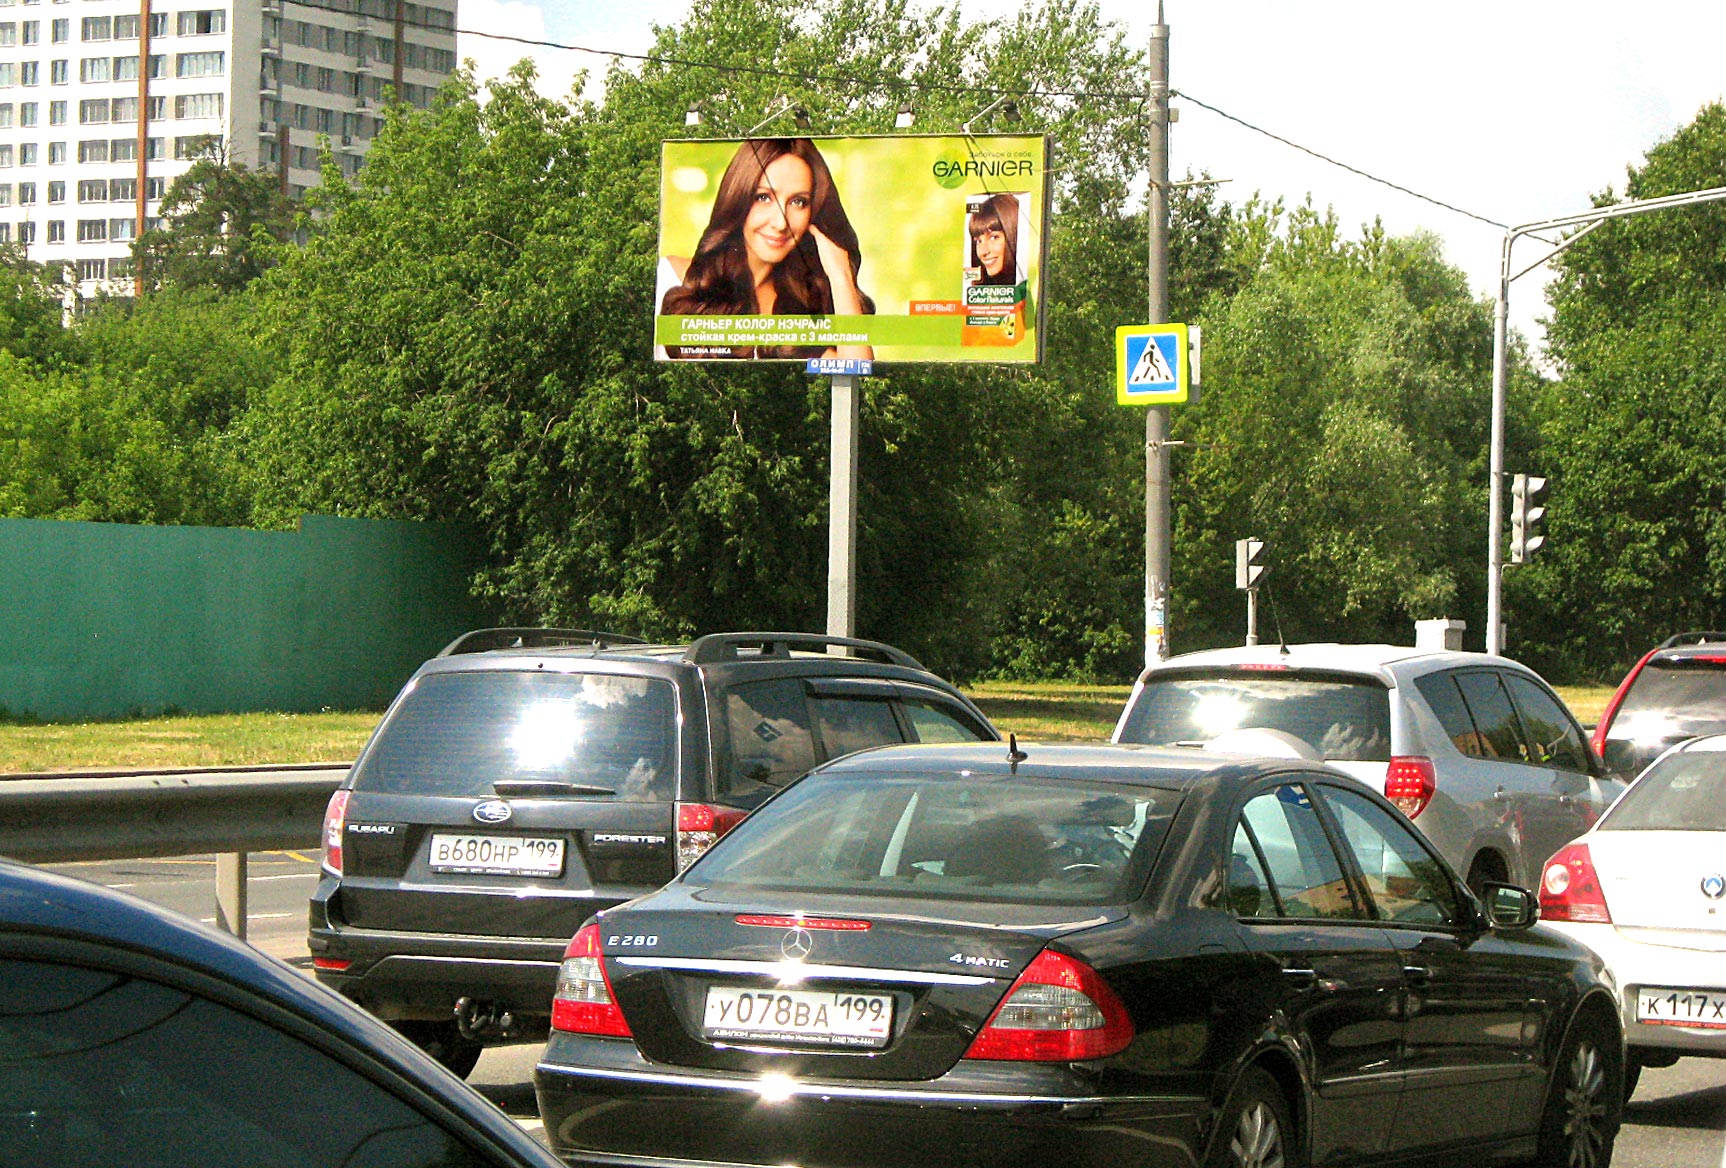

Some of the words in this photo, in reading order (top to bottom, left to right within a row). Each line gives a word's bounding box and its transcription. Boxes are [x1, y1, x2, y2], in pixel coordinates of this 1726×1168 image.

[933, 160, 1033, 177] GARNIER
[968, 287, 1014, 296] GARNIER
[915, 303, 956, 312] ВПЕРВЫЕ!
[681, 318, 732, 329] ГАРНЬЕР
[735, 318, 775, 329] КОЛОР
[778, 318, 831, 329] НЭЧРАЛС
[680, 331, 725, 342] стойкая
[727, 332, 798, 344] крем-краска
[800, 333, 807, 342] с
[809, 331, 816, 342] 3
[818, 332, 868, 342] маслами
[348, 824, 395, 834] SUBARU
[594, 834, 666, 844] FORESTER
[526, 840, 558, 858] 199
[839, 996, 884, 1023] 199
